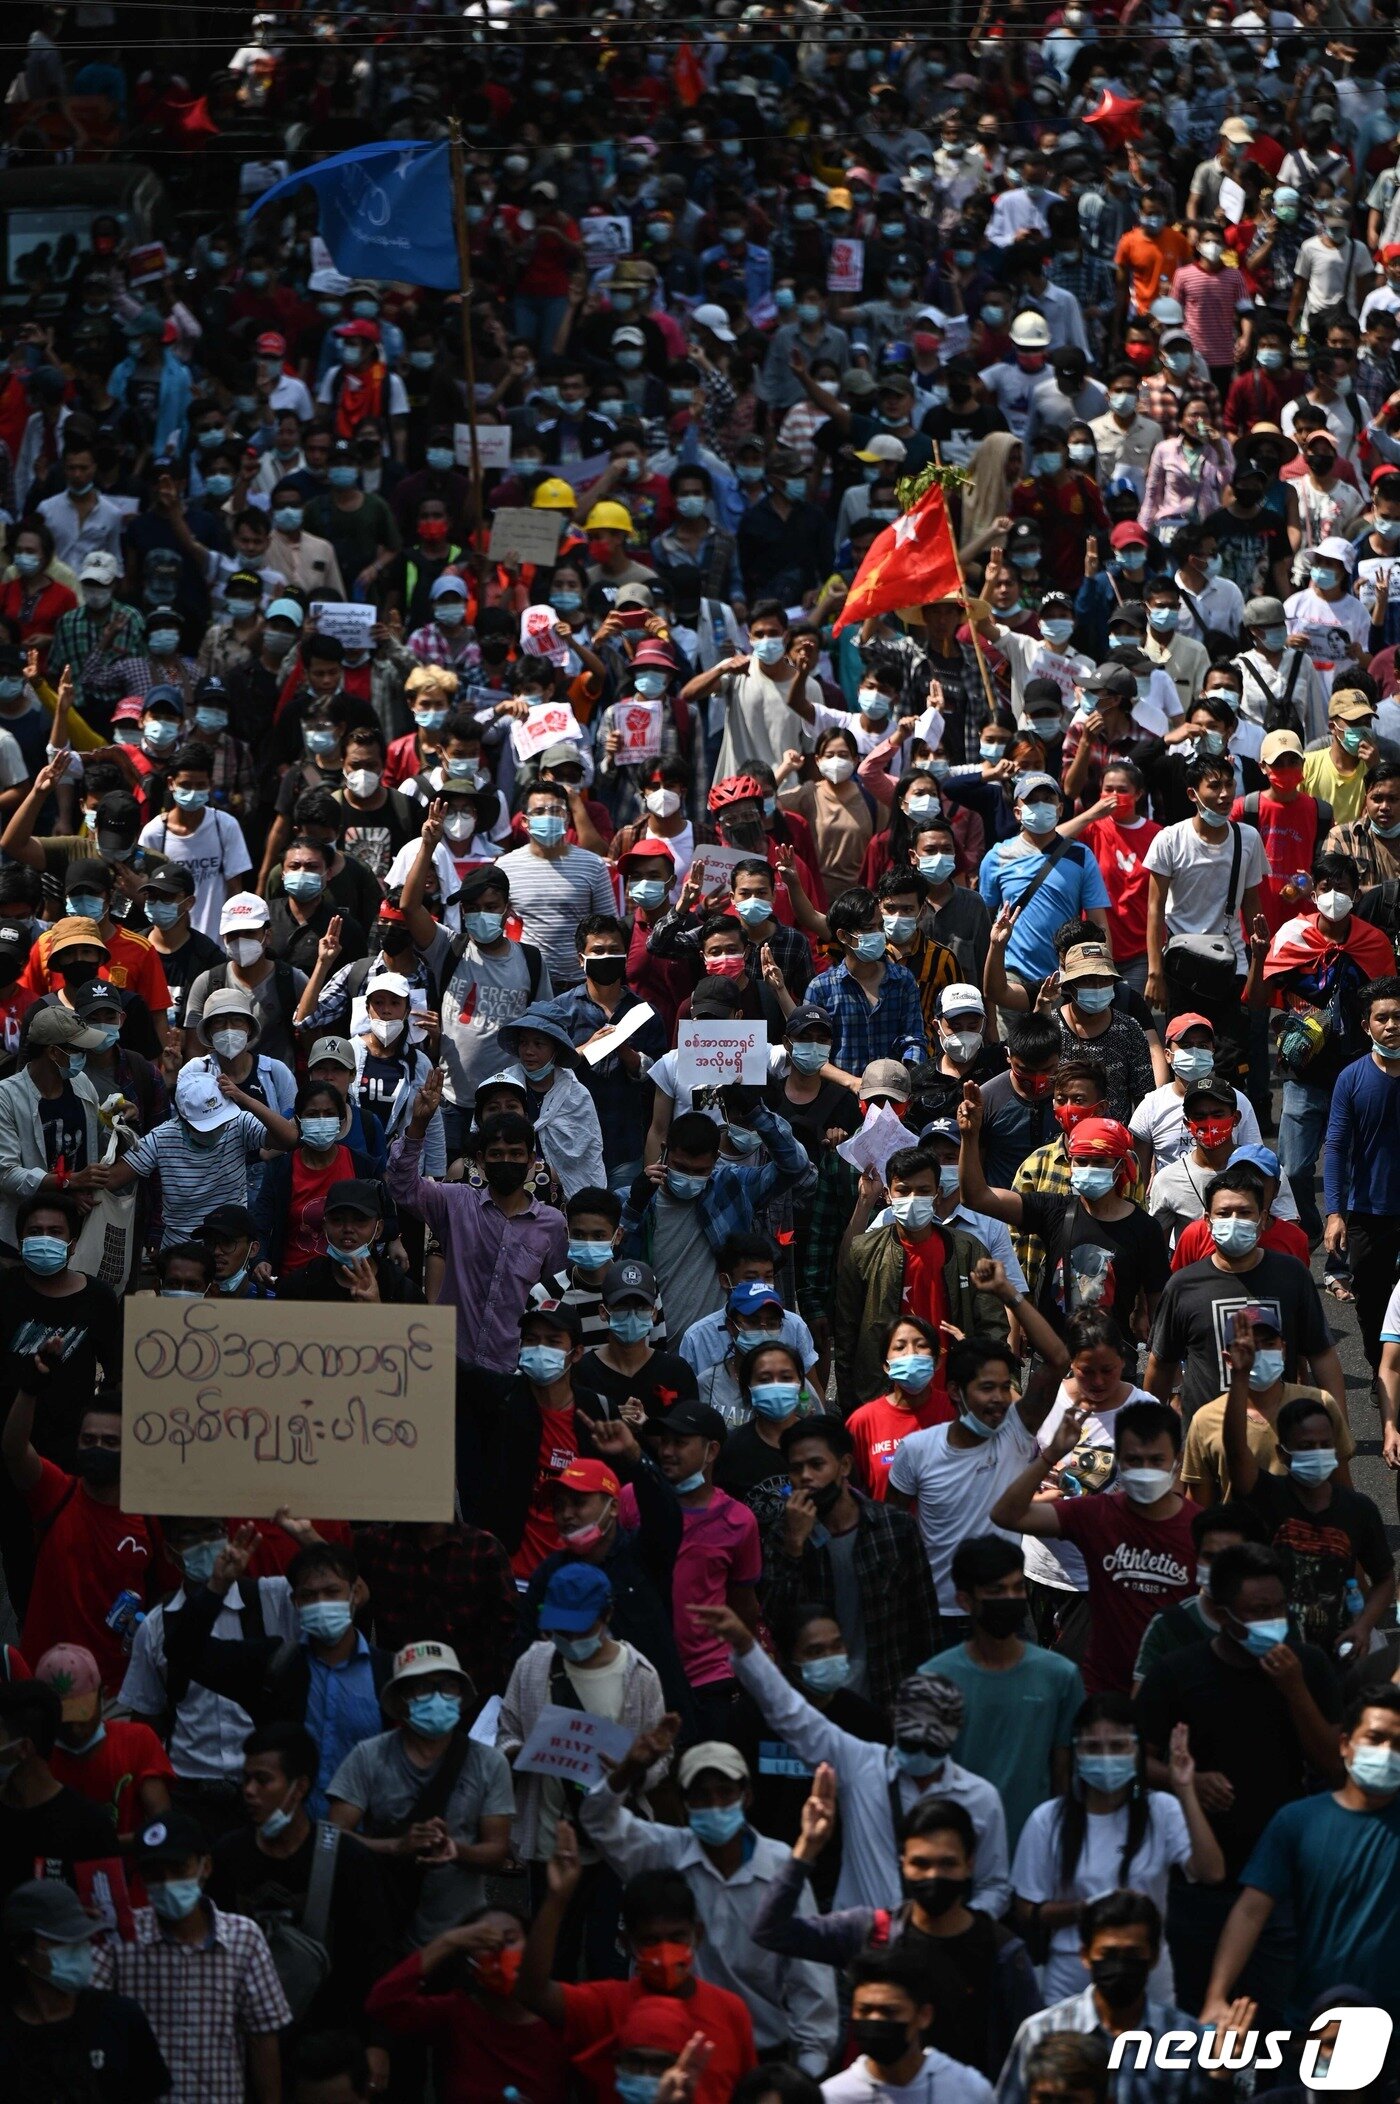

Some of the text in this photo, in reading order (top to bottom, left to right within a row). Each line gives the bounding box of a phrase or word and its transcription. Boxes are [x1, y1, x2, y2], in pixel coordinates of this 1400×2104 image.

[1041, 591, 1066, 604] NYC
[449, 976, 528, 1006] RE FRESH
[684, 1033, 755, 1053] စစ်အာဏာရှင်
[695, 1051, 743, 1073] အလိုမရှိ
[872, 1440, 892, 1455] LIKE
[1103, 1542, 1188, 1581] Athletics
[570, 1720, 595, 1735] WE
[550, 1737, 593, 1754] WANT
[532, 1752, 590, 1774] JUSTICE
